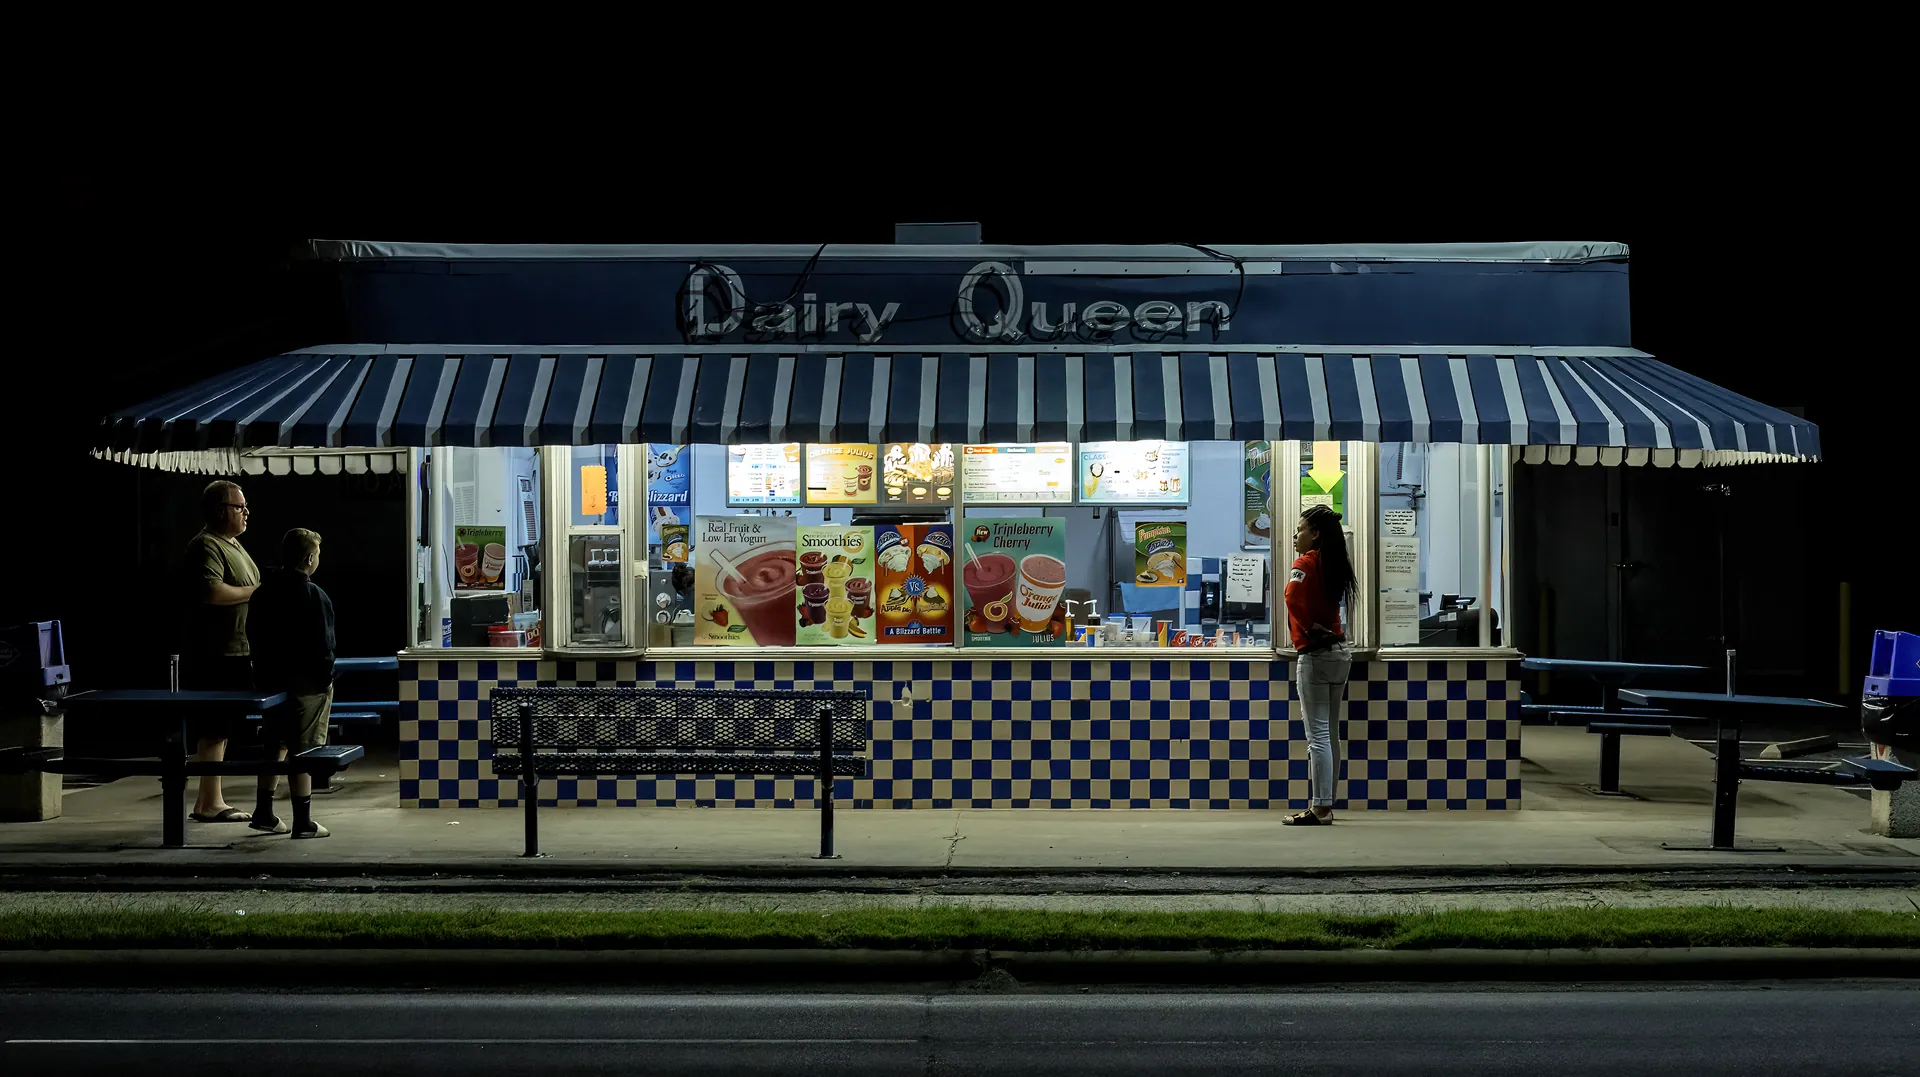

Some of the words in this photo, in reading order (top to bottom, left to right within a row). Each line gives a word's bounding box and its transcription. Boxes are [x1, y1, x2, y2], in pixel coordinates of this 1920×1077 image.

[689, 264, 900, 342] Dairy
[958, 262, 1230, 341] Queen
[847, 447, 874, 460] JULIUS
[648, 490, 688, 502] lizzard
[466, 528, 504, 537] Tripleberry
[708, 523, 726, 533] Real
[729, 523, 750, 533] Fruit
[752, 524, 761, 533] &
[993, 523, 1054, 537] Tripleberry
[702, 532, 721, 542] Low
[724, 533, 736, 542] Fat
[739, 533, 767, 546] Yogurt
[802, 534, 862, 547] Smoothies
[993, 536, 1031, 551] Cherry
[881, 604, 901, 614] Apple
[1021, 597, 1052, 610] Julius
[1032, 634, 1055, 644] JULIUS
